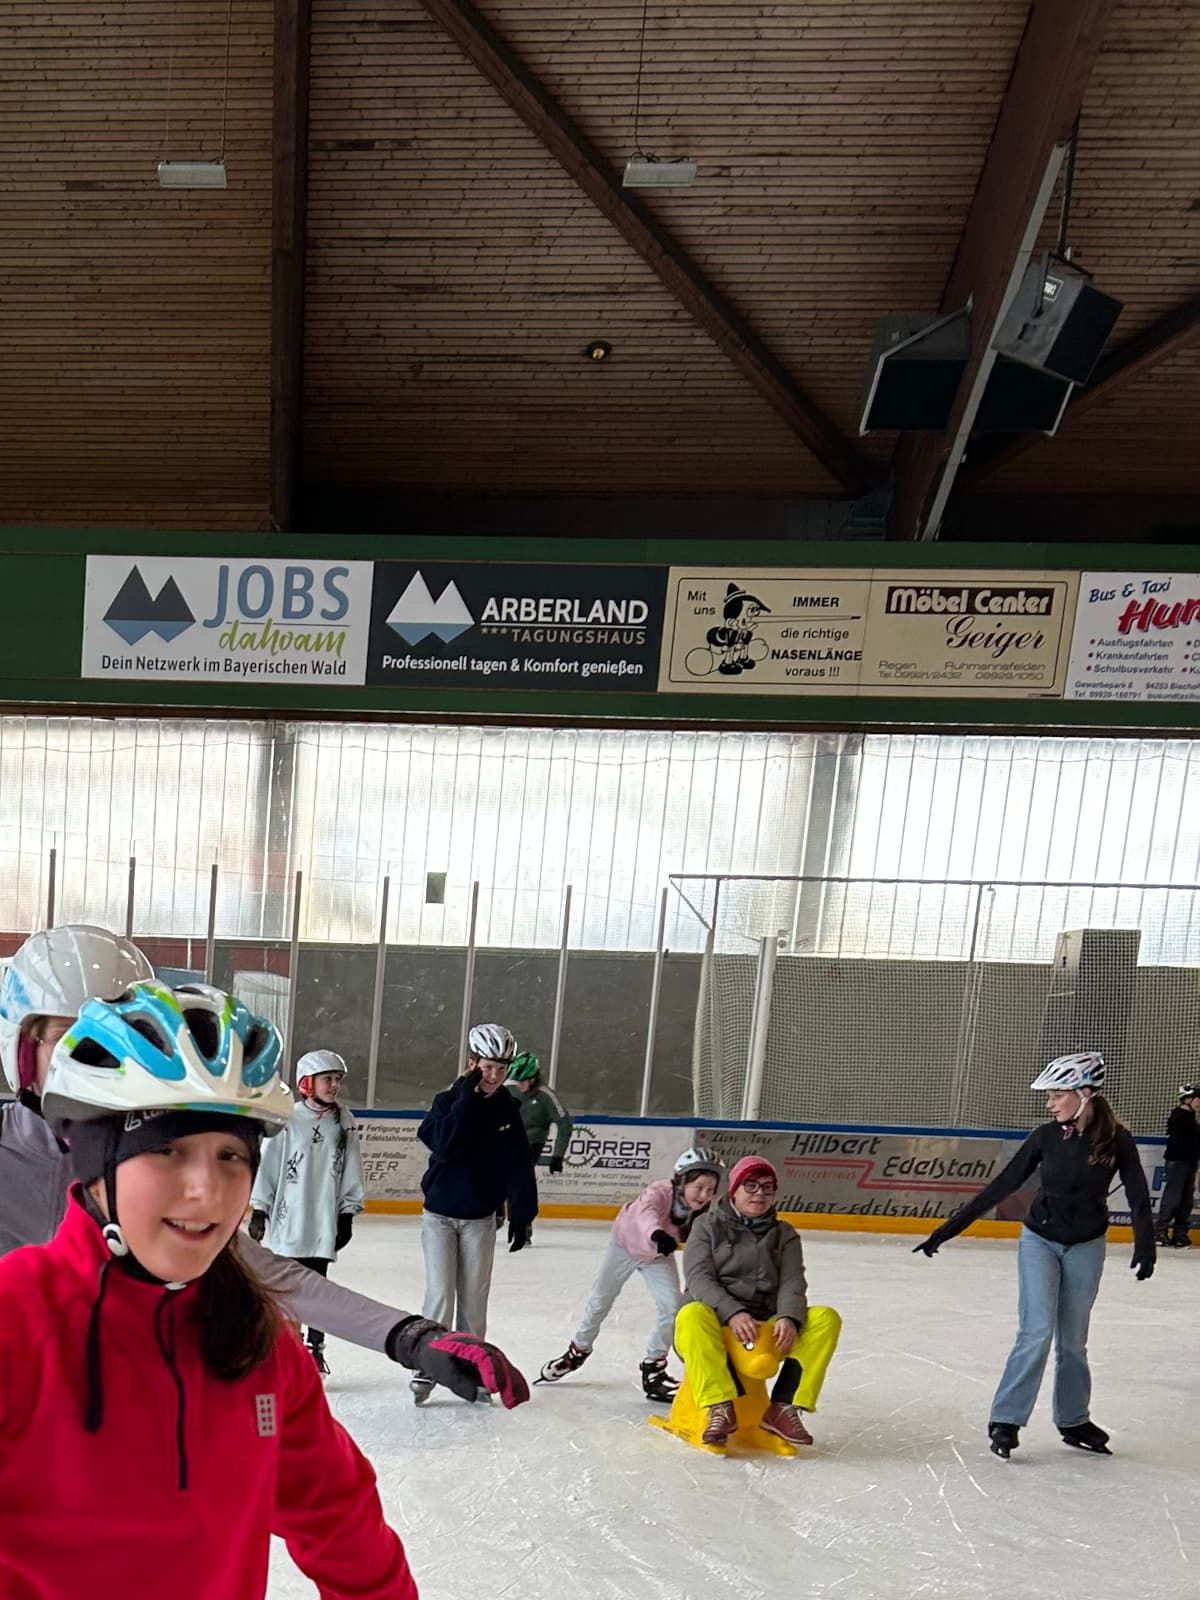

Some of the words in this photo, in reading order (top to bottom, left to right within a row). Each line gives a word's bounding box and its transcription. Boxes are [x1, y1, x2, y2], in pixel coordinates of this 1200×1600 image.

[203, 564, 350, 628] JOBS
[687, 590, 707, 602] Mit
[1088, 588, 1117, 603] Bus
[1121, 582, 1136, 598] &
[1141, 576, 1173, 595] Taxi
[792, 596, 840, 608] IMMER
[889, 588, 970, 613] Möbel
[974, 589, 1050, 614] Center
[481, 597, 649, 625] ARBERLAND
[693, 606, 716, 616] uns
[218, 618, 347, 658] dahoam
[511, 628, 646, 645] TAGUNGSHAUS
[780, 627, 799, 639] die
[802, 627, 850, 642] richtige
[945, 615, 1047, 659] Geiger
[1096, 637, 1174, 649] Ausflugsfahrten
[770, 647, 864, 661] NASENLÄNGE
[1095, 650, 1169, 661] Krankenfahrten
[101, 655, 133, 671] Dein
[136, 656, 201, 673] Netzwerk
[204, 658, 221, 673] im
[224, 658, 308, 677] Bayerischen
[312, 660, 347, 676] Wald
[382, 654, 467, 671] Professionell
[470, 657, 507, 675] tagen
[511, 658, 520, 672] &
[524, 658, 579, 674] Komfort
[582, 659, 643, 677] genießen
[785, 667, 825, 677] voraus
[828, 666, 840, 677] !!!
[878, 660, 917, 671] Regen
[944, 660, 1046, 672] Ruhmannsfelden
[1093, 663, 1175, 674] Schulbusverkehr
[790, 1133, 882, 1157] Hilbert
[882, 1155, 997, 1179] Edelstahl
